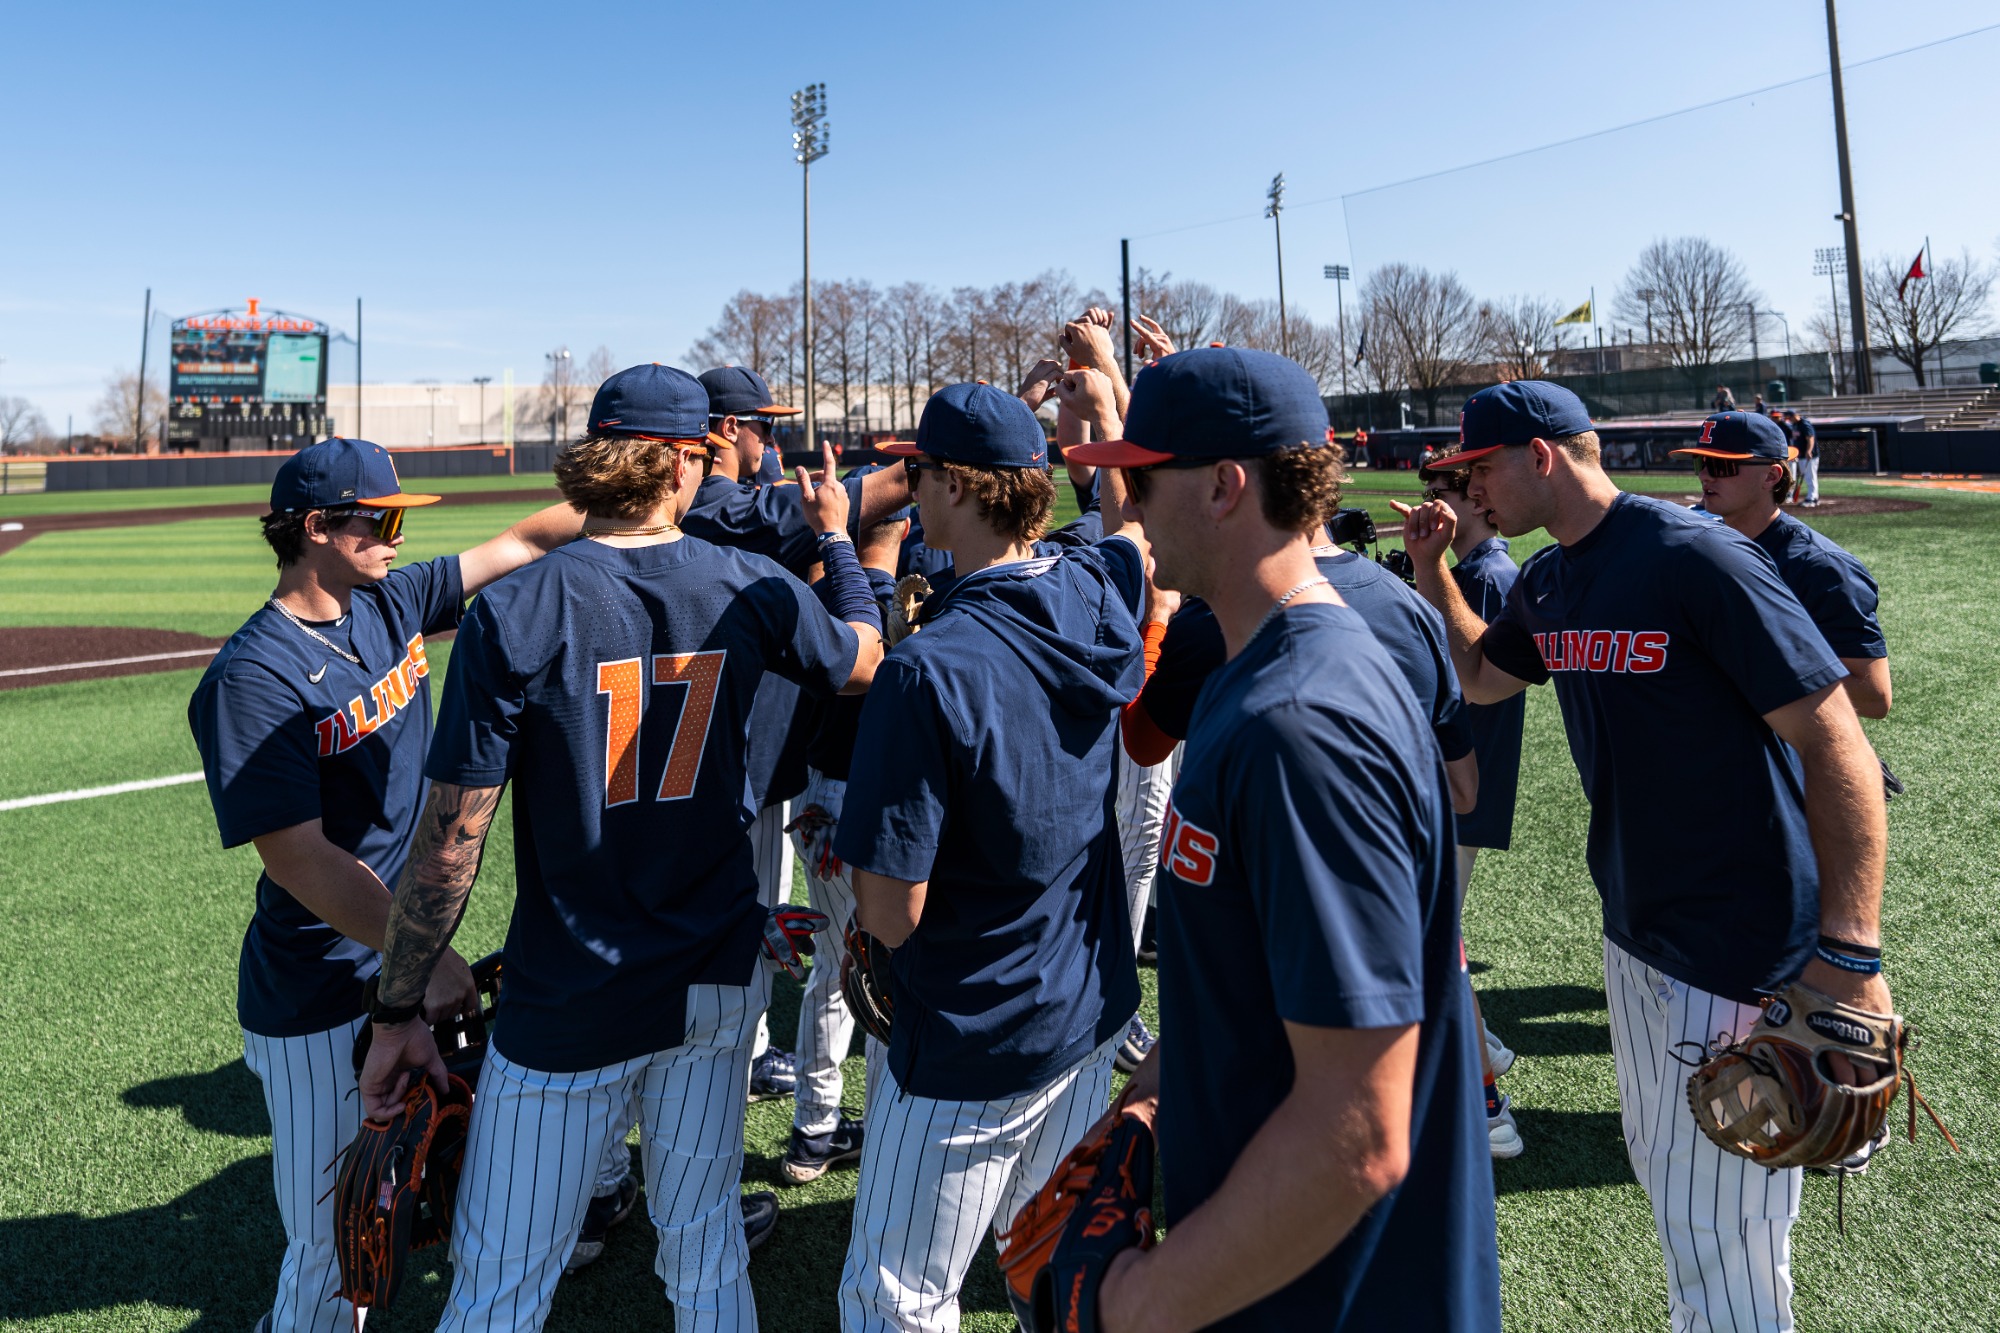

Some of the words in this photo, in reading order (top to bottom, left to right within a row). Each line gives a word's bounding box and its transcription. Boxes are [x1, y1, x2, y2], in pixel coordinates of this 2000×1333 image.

[246, 298, 260, 316] I
[187, 317, 261, 331] ILLINOIS
[266, 319, 315, 332] FIELD
[1699, 420, 1717, 444] I
[315, 632, 430, 757] ILLINOS
[597, 649, 727, 809] 17
[1811, 1015, 1870, 1044] Wilson
